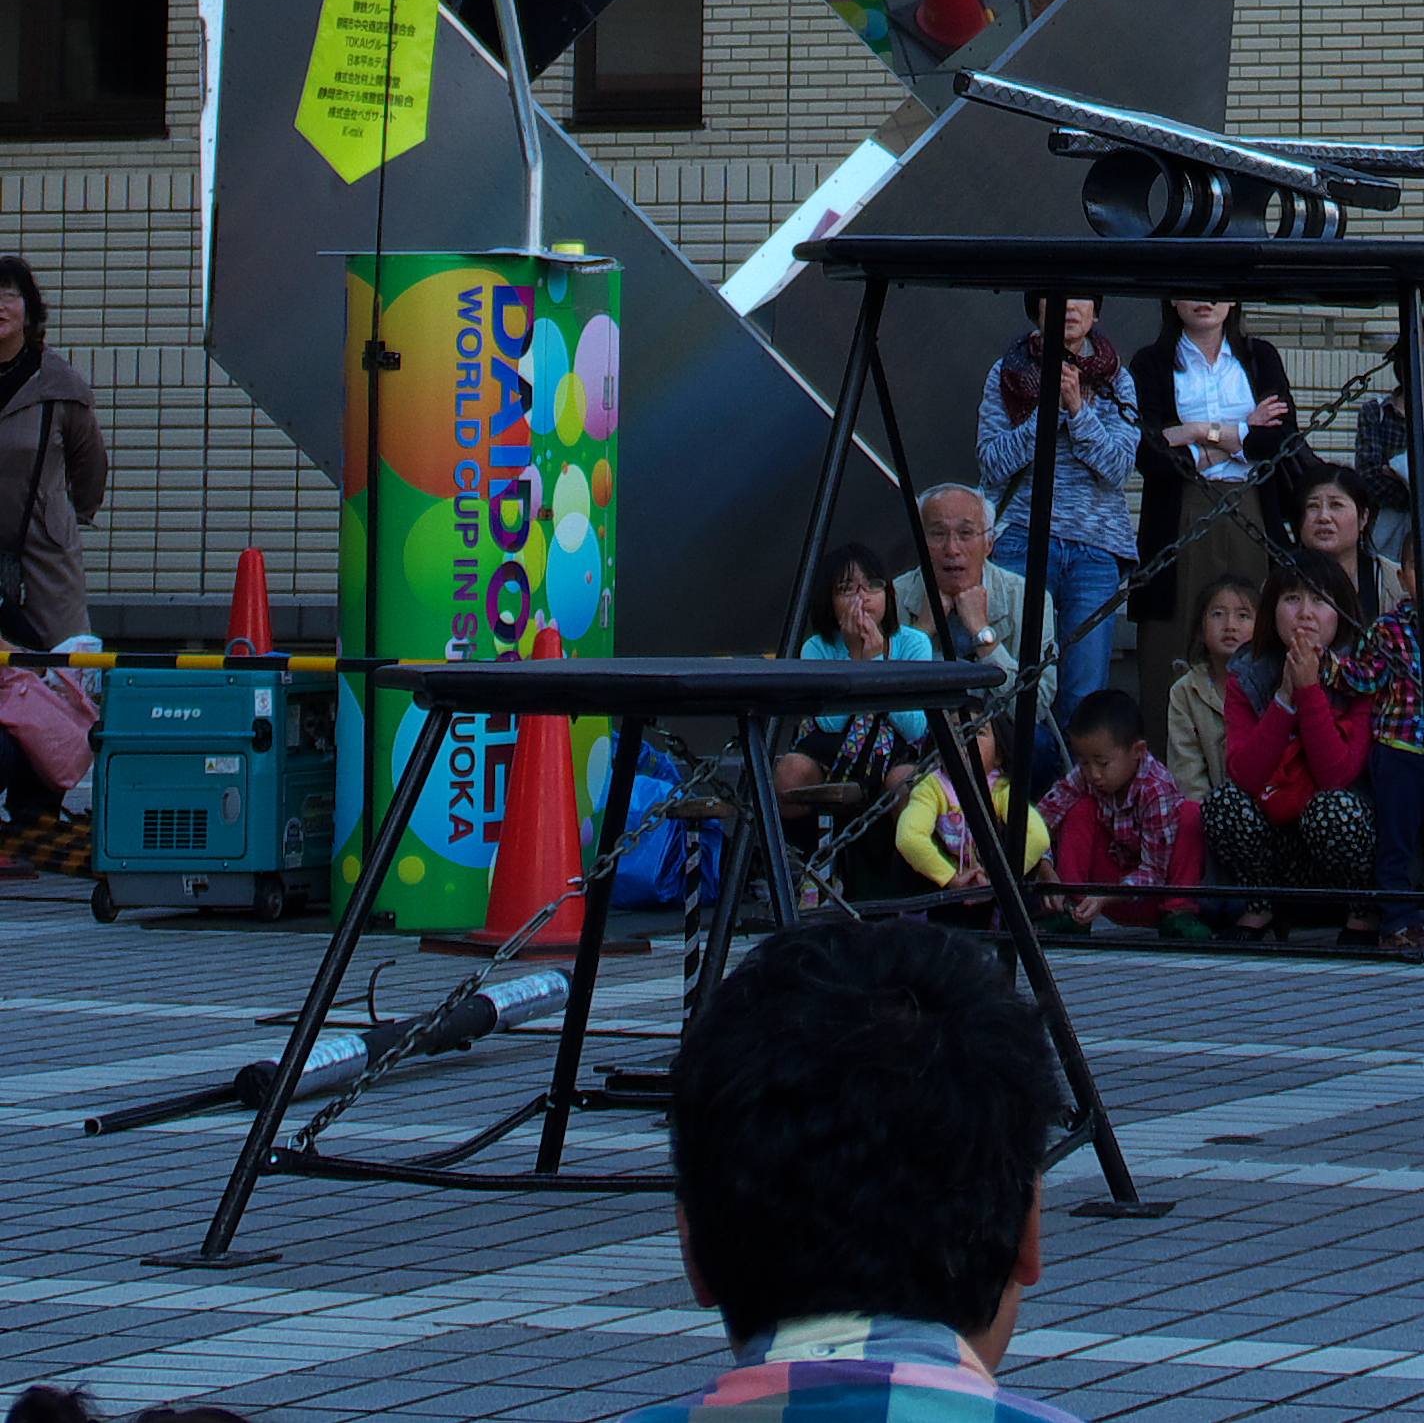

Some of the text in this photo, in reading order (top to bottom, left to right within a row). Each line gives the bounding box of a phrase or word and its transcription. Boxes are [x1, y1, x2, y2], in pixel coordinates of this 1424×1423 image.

[455, 285, 484, 449] WORLD
[453, 459, 482, 549] CUP
[453, 559, 479, 602] IN
[151, 706, 202, 721] Denyo
